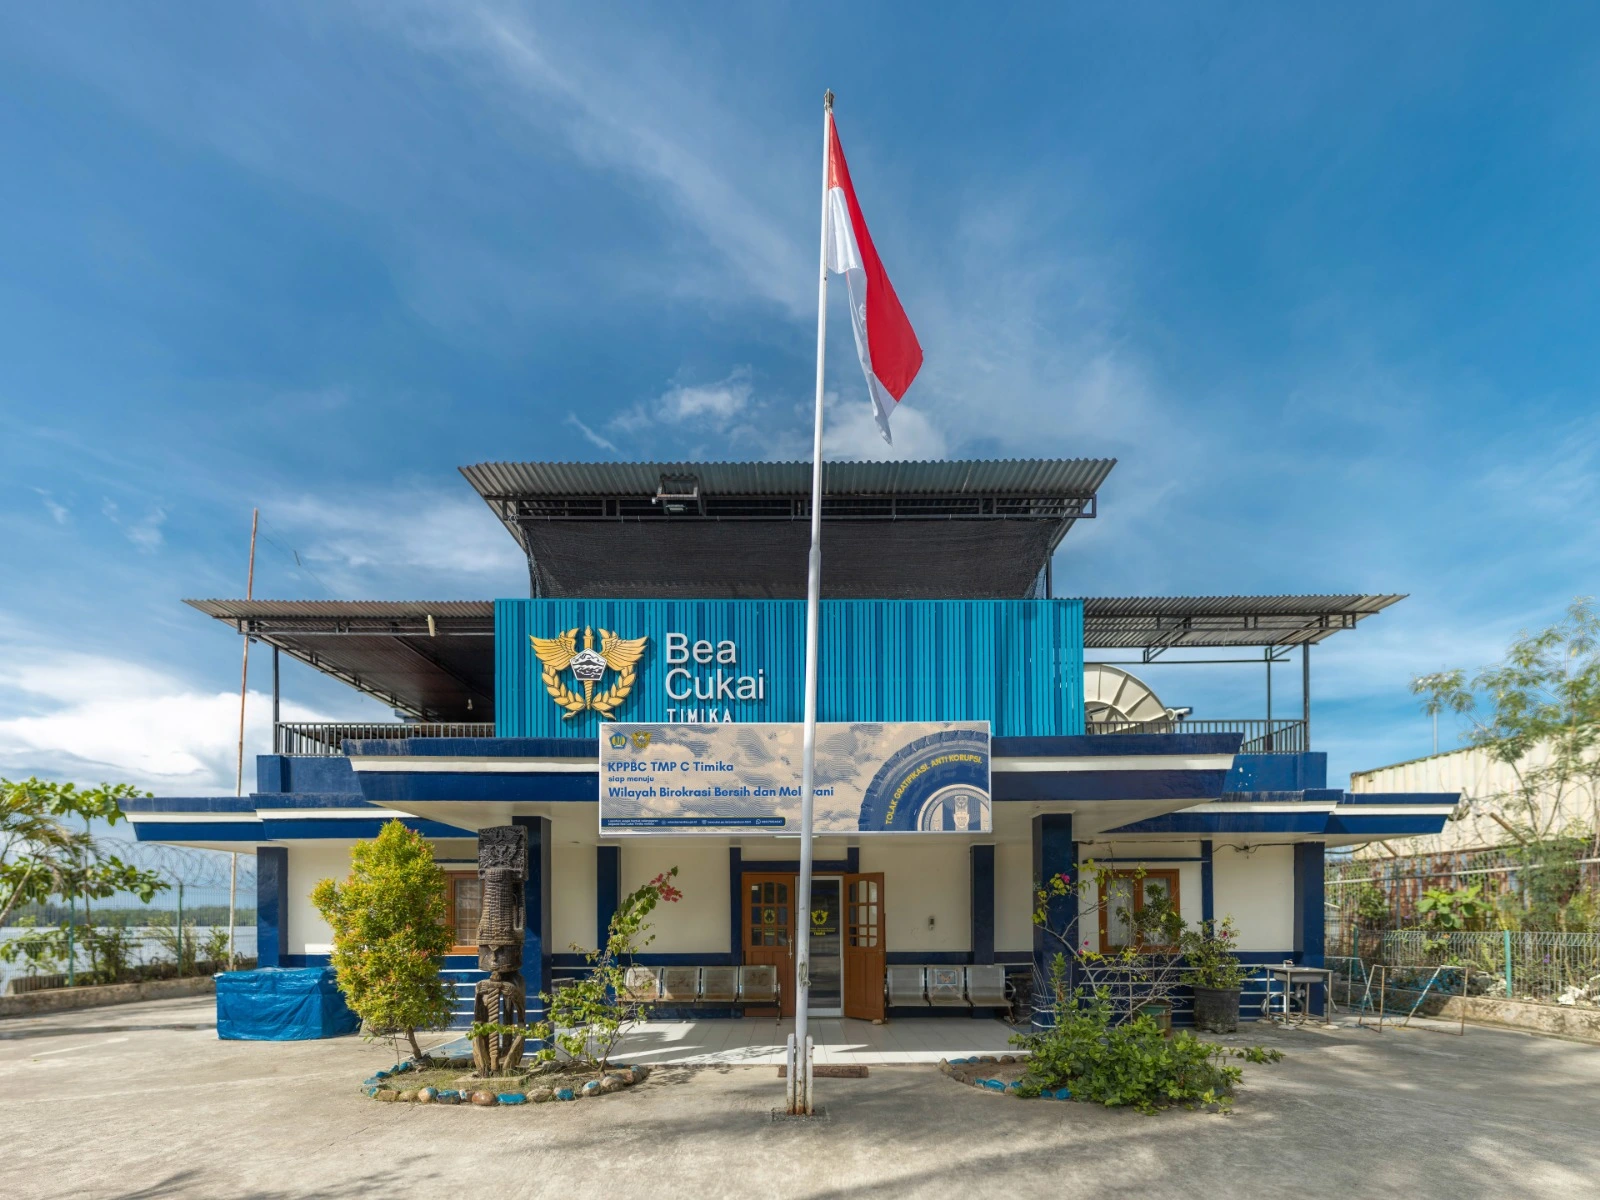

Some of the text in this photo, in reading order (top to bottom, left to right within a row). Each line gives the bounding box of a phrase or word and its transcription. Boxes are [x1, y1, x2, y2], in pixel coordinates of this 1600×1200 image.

[665, 632, 737, 664] Bea
[665, 668, 764, 700] Cukai
[666, 708, 733, 723] TIMIKA
[608, 761, 734, 772] KPPBC TMP C Timika
[608, 776, 655, 784] siap menuju
[608, 786, 834, 800] Wilayah Birokrasi Bersih dan Melani
[885, 800, 898, 825] TOLAK
[931, 755, 949, 767] ANTI
